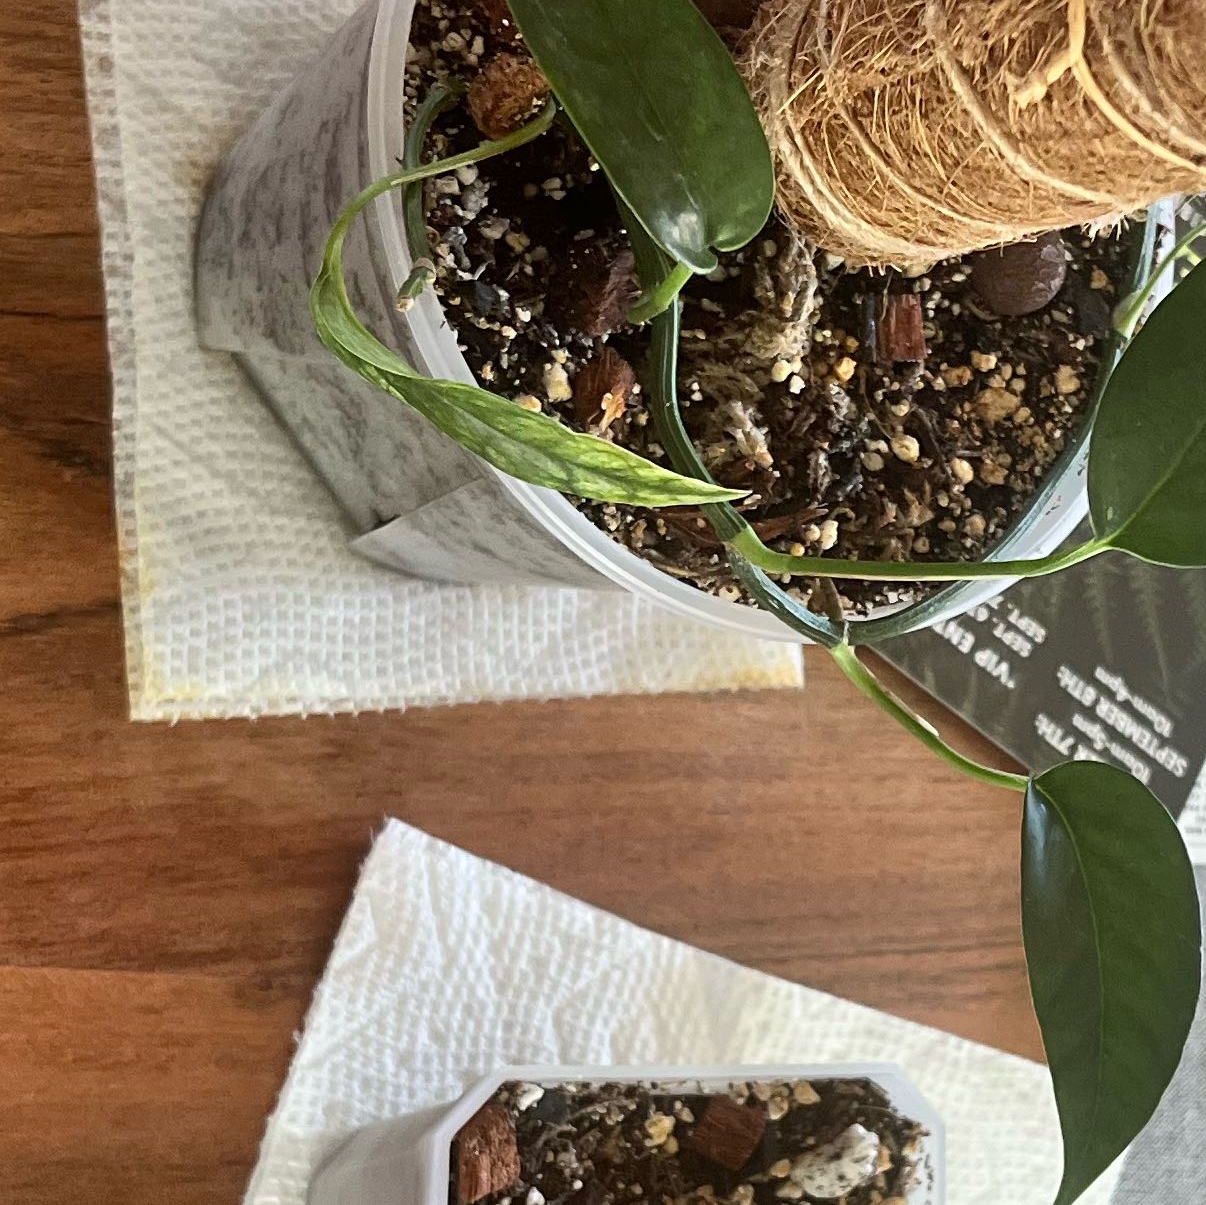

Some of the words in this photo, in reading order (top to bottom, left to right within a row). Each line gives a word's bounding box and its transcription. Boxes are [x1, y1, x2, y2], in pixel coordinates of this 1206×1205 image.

[992, 618, 1033, 657] SEPT.
[1007, 603, 1046, 643] SEPT.
[1095, 666, 1173, 738] 10am-4pm
[1096, 696, 1188, 777] SEPTEMBER
